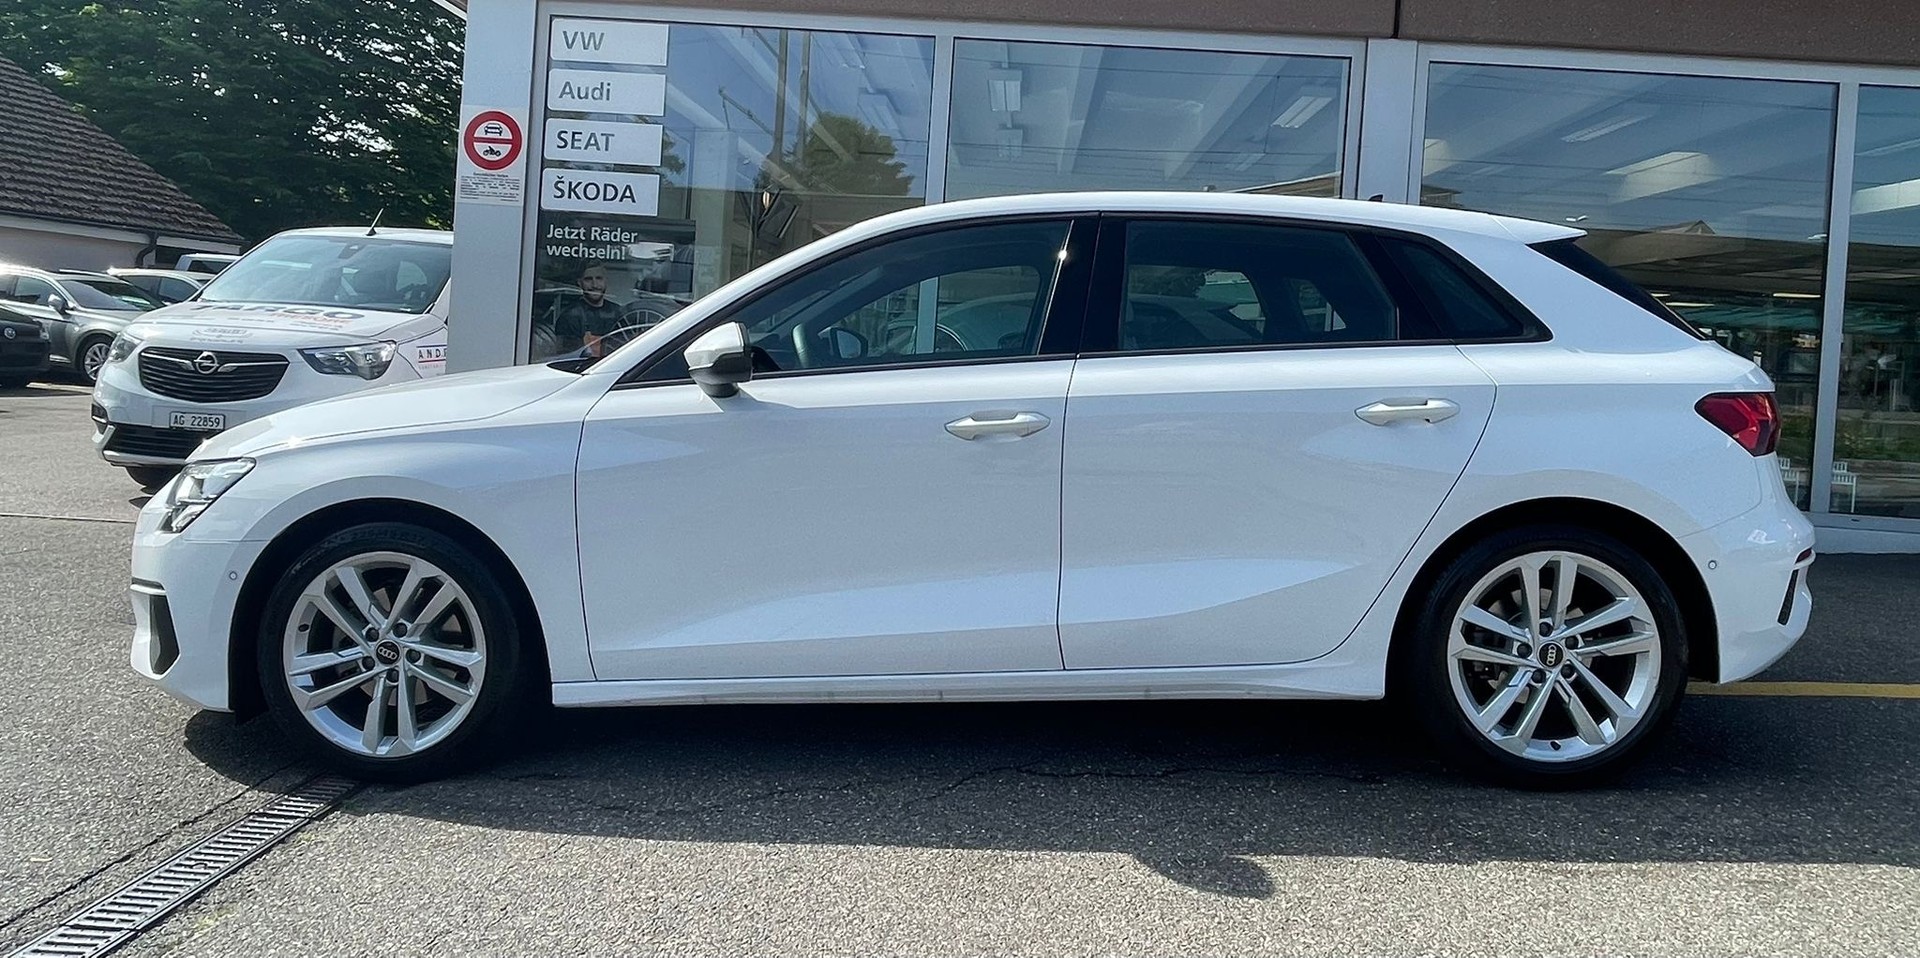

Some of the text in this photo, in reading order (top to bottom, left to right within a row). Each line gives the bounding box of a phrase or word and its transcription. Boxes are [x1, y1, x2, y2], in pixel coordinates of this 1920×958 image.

[562, 30, 605, 51] VW
[558, 80, 612, 101] Audi
[556, 130, 615, 152] SEAT
[553, 175, 637, 204] ŠKODA
[546, 224, 638, 243] Jetzt Räder
[546, 242, 626, 260] wechseln!
[173, 414, 221, 428] AG 22859
